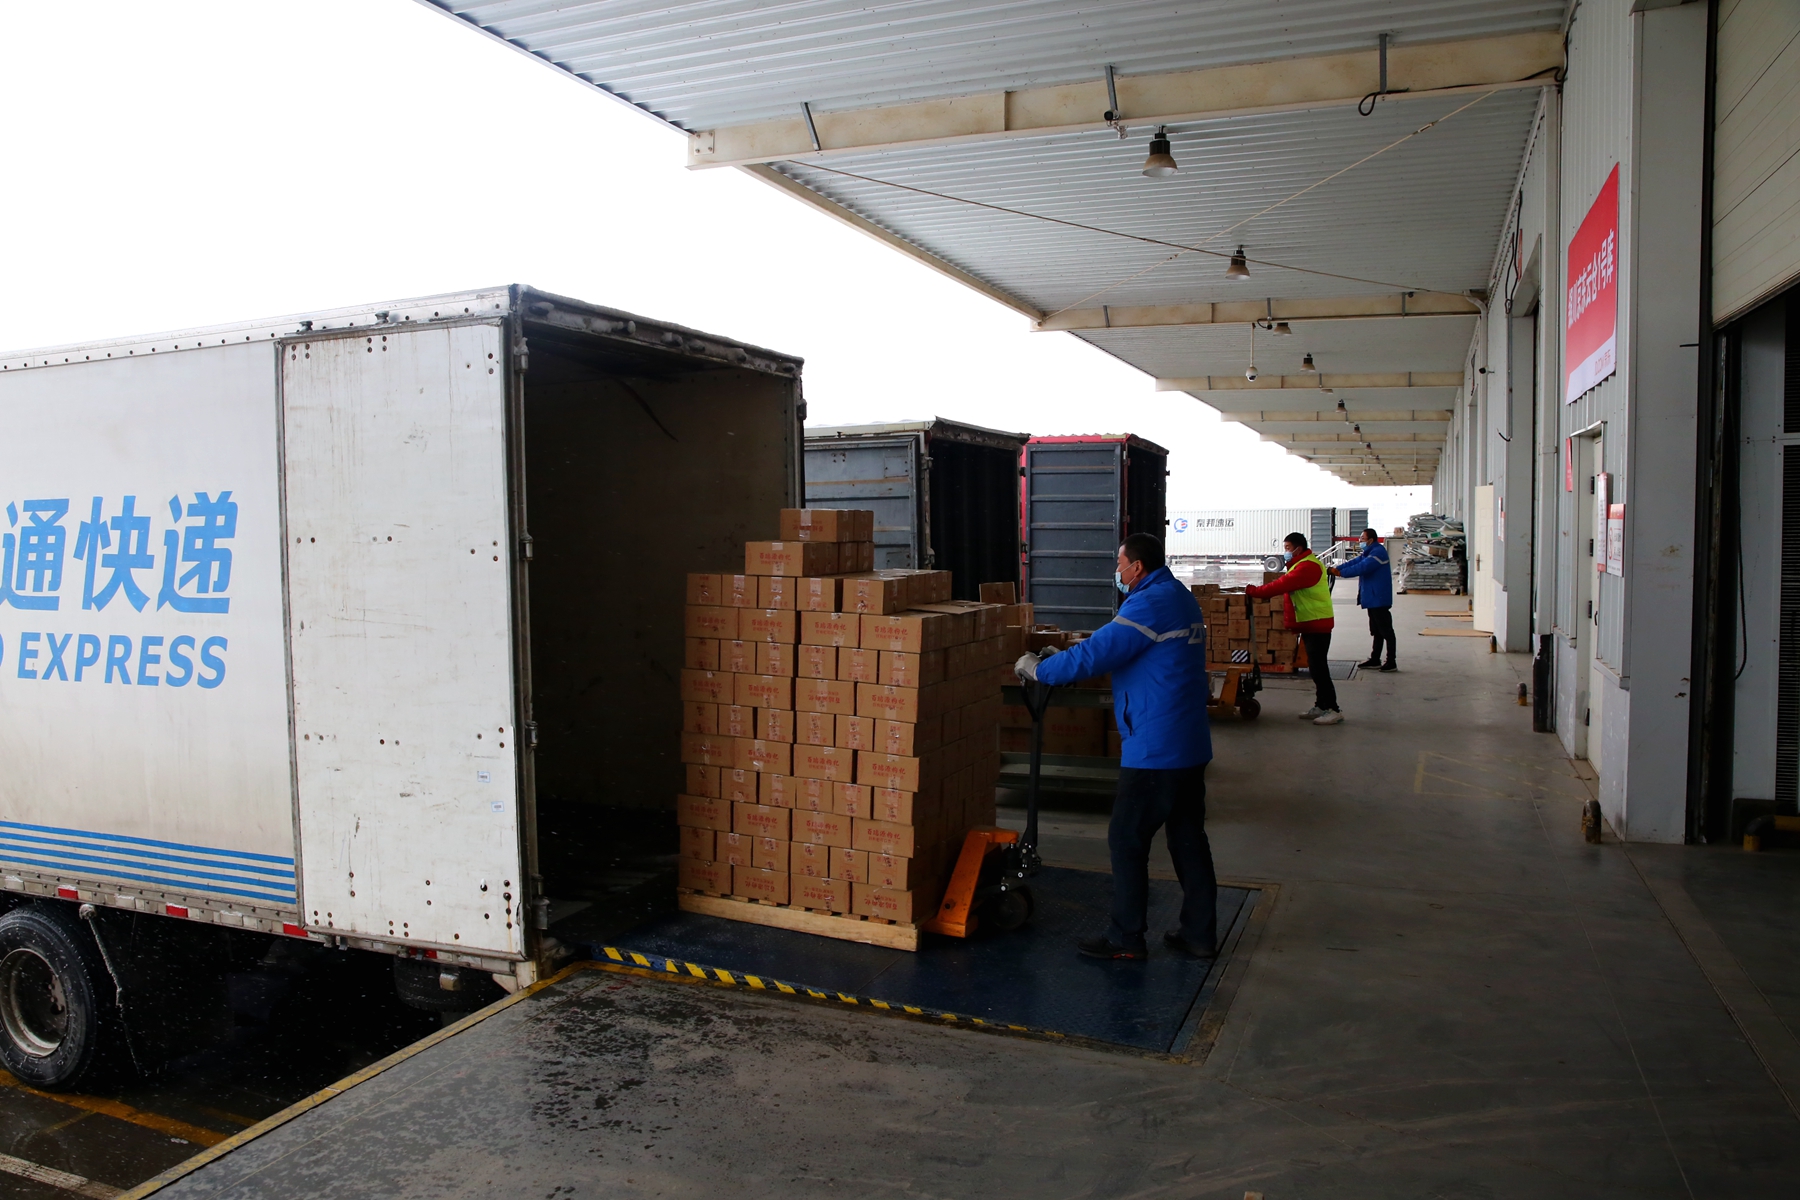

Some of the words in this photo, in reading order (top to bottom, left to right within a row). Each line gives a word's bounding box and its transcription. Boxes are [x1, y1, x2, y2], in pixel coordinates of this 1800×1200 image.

[0, 491, 238, 614] 通快递
[17, 632, 228, 689] EXPRESS
